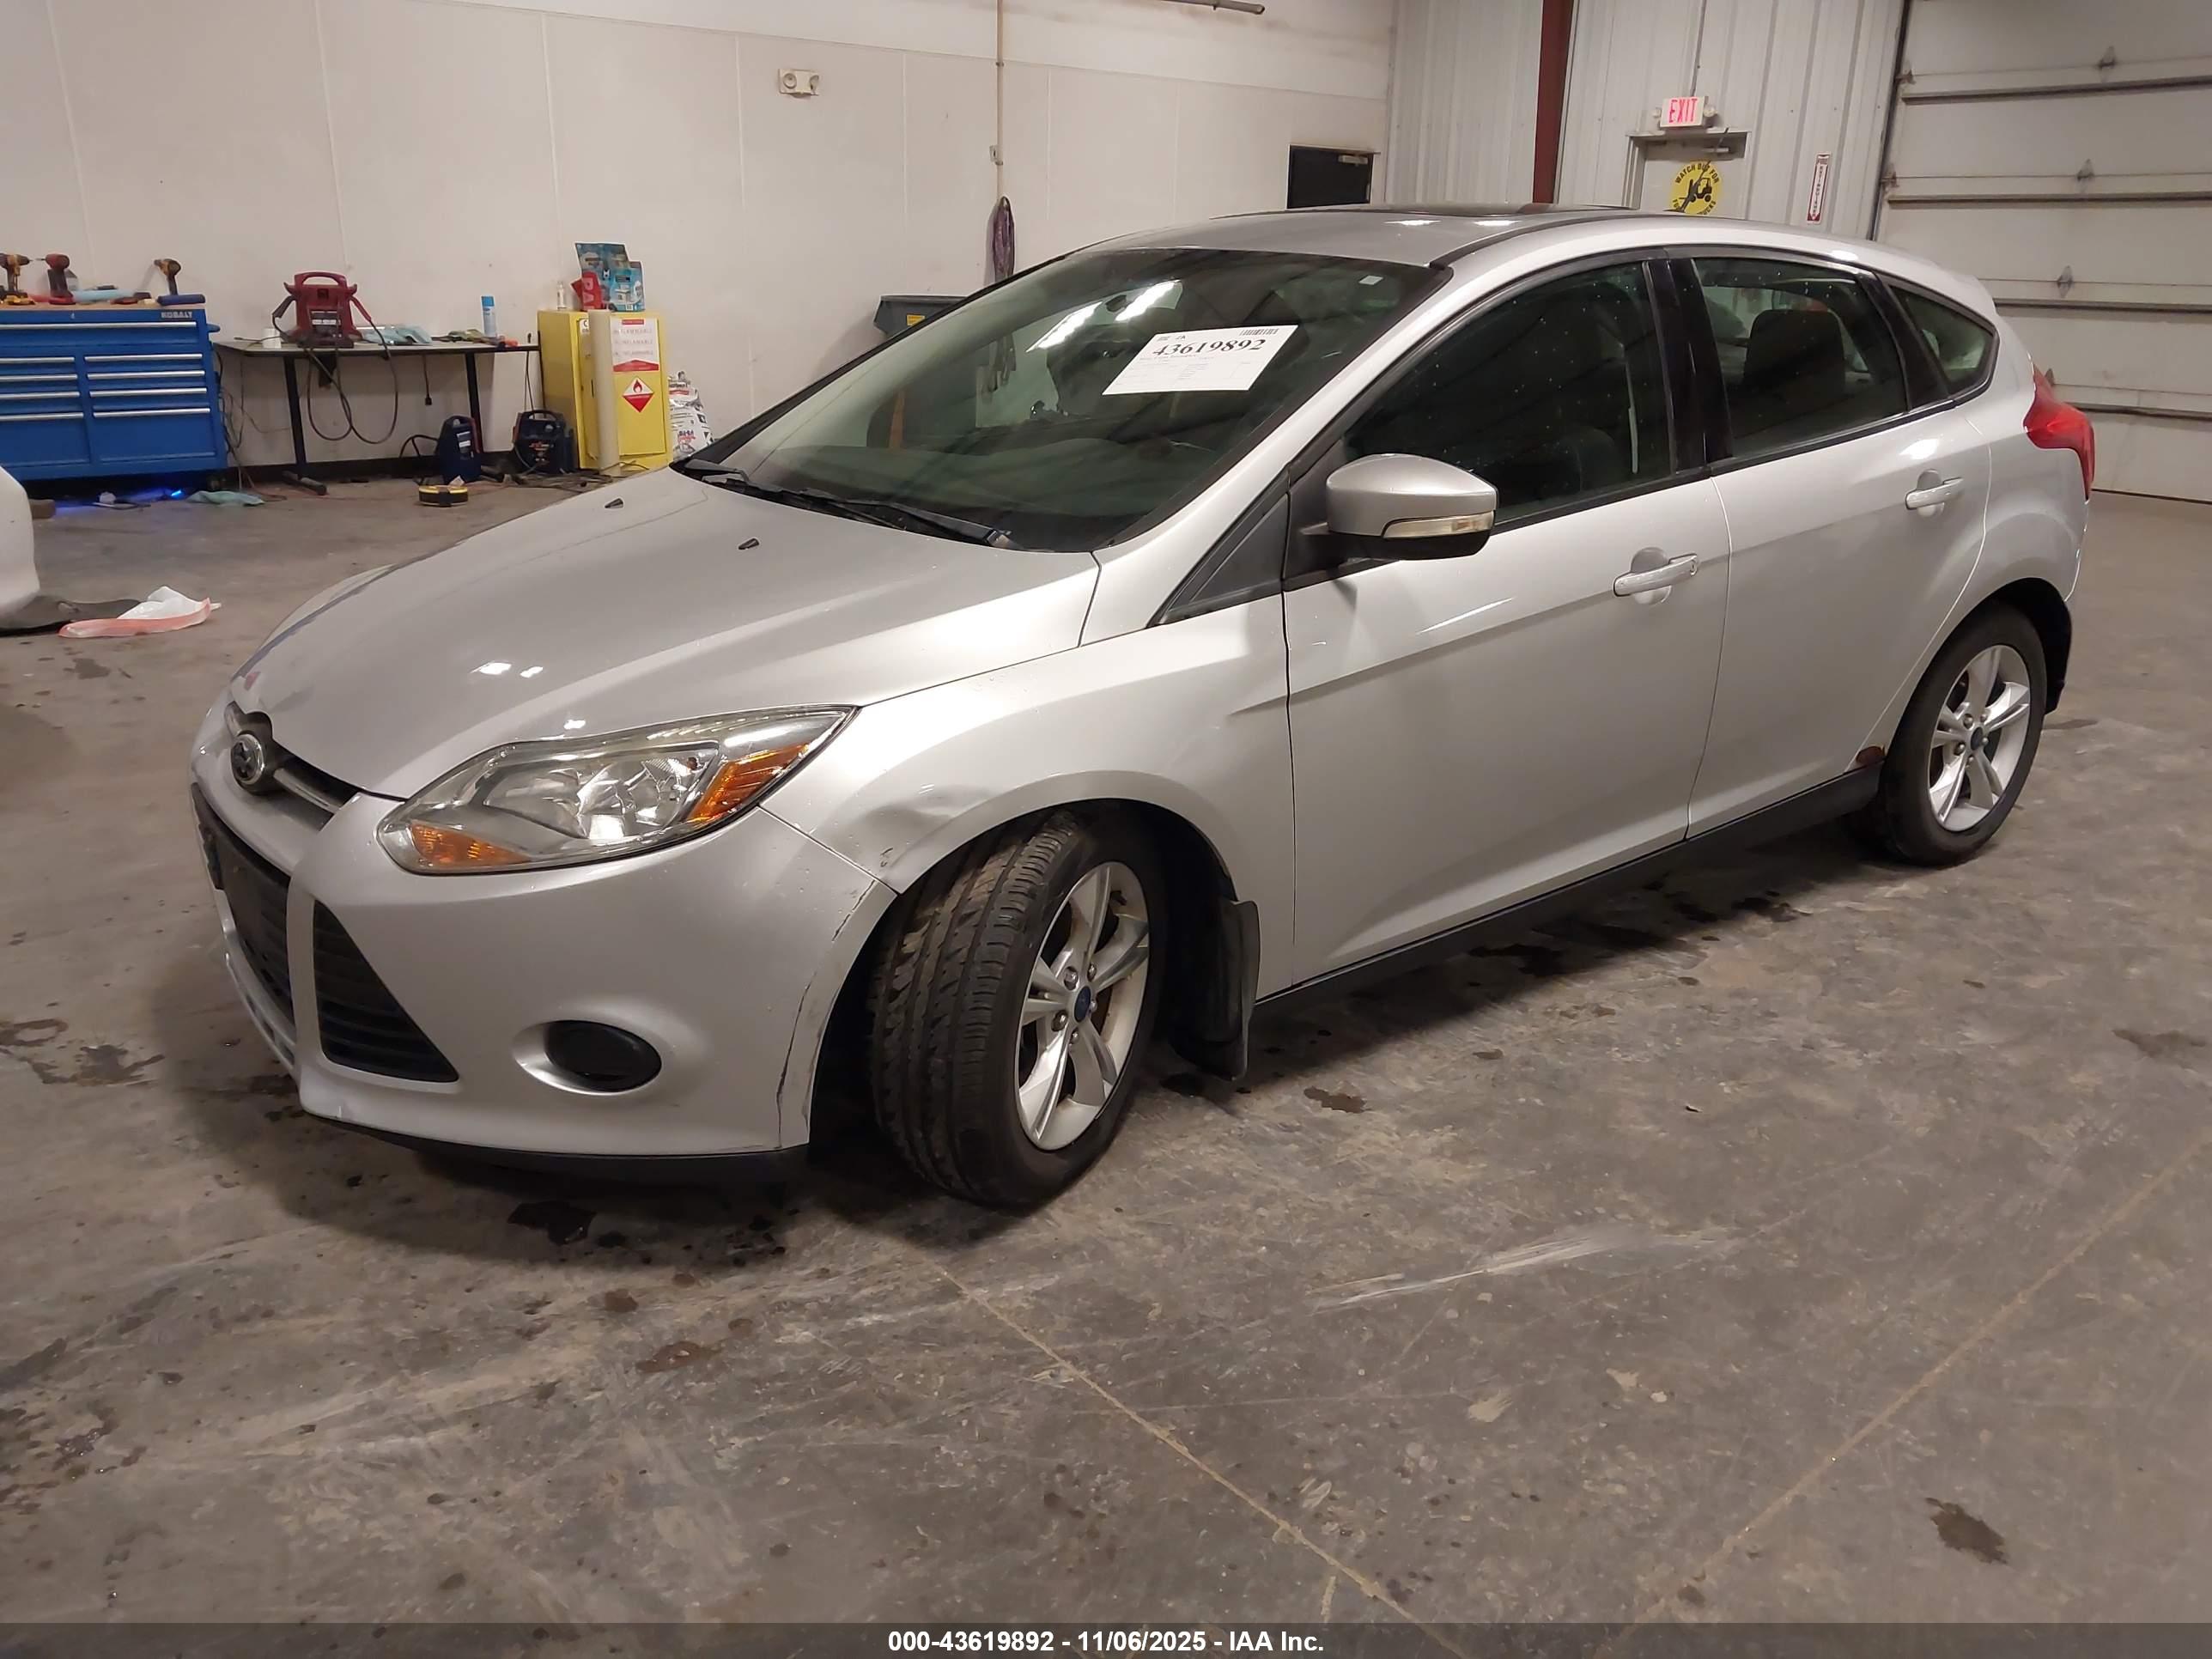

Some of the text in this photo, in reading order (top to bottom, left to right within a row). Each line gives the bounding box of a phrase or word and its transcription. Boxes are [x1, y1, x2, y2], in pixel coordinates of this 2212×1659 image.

[1668, 98, 1698, 123] EXIT
[1675, 165, 1696, 184] WATCH
[1709, 169, 1720, 184] FOR
[1152, 338, 1266, 356] 43619892
